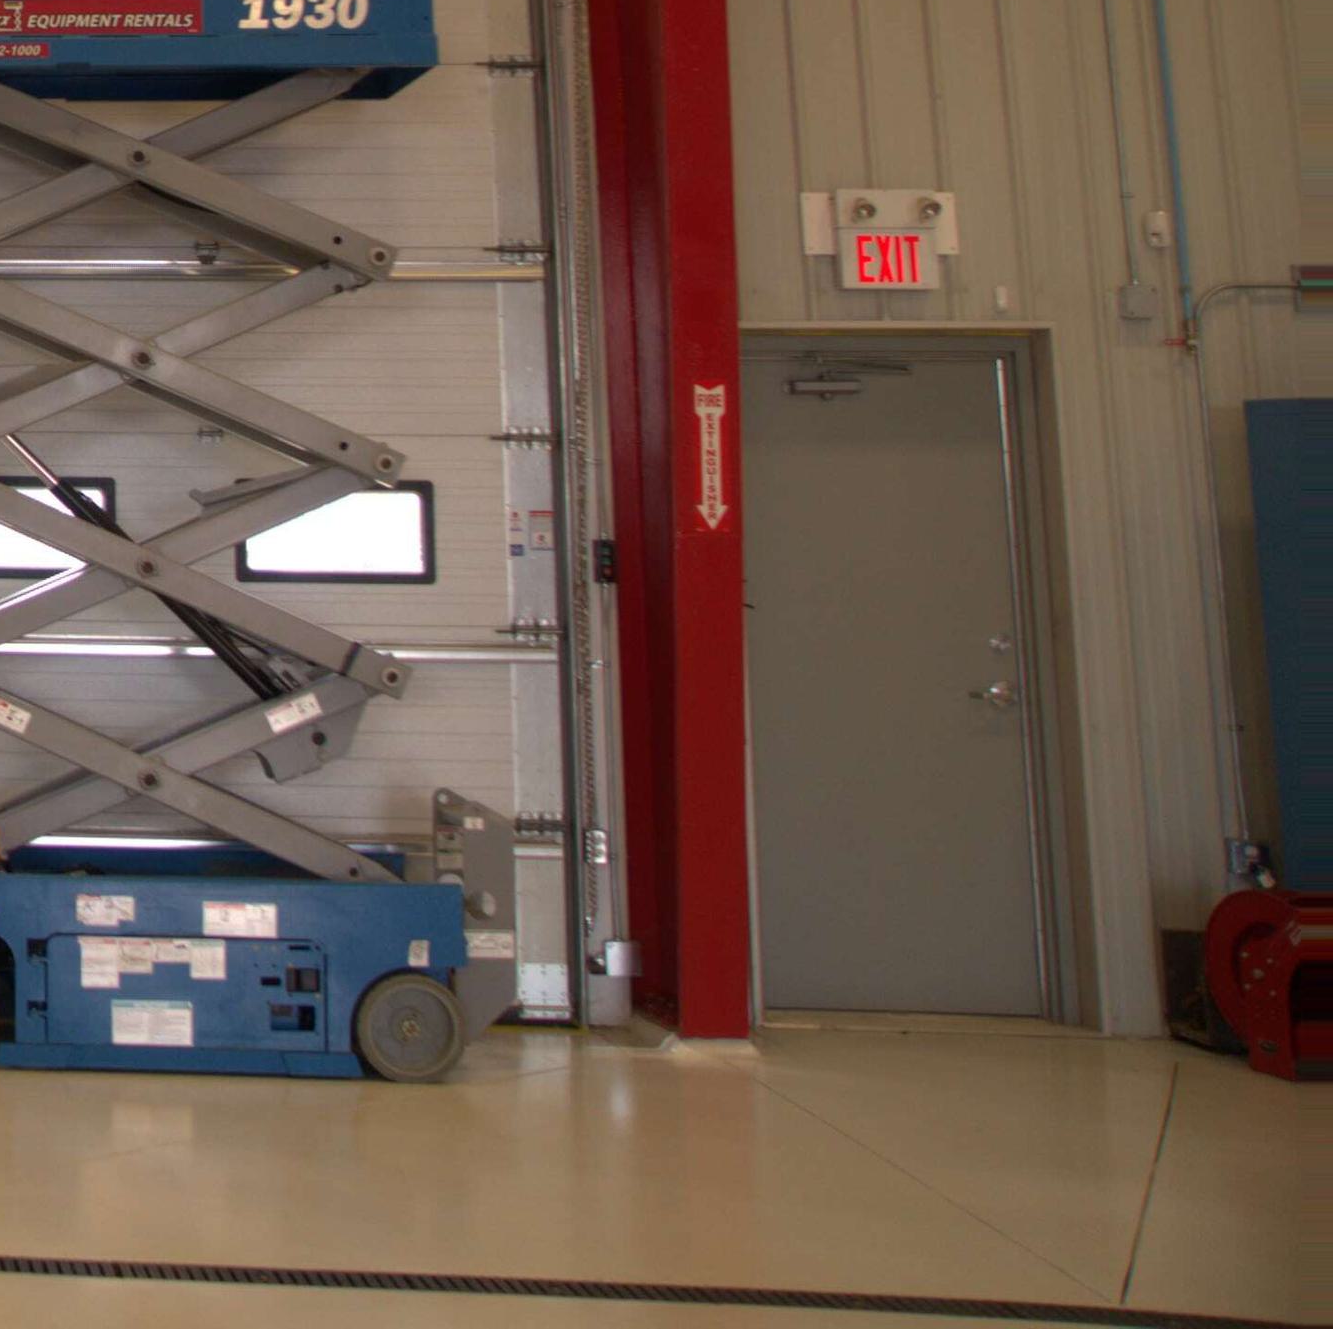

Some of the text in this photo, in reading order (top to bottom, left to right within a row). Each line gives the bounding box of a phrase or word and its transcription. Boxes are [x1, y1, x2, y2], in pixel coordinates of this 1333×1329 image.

[27, 14, 120, 28] EQUIPMENT
[123, 14, 194, 27] RENTALS
[856, 235, 920, 283] EXIT
[697, 393, 722, 407] FIRE
[706, 413, 718, 520] EXTINGUISHER
